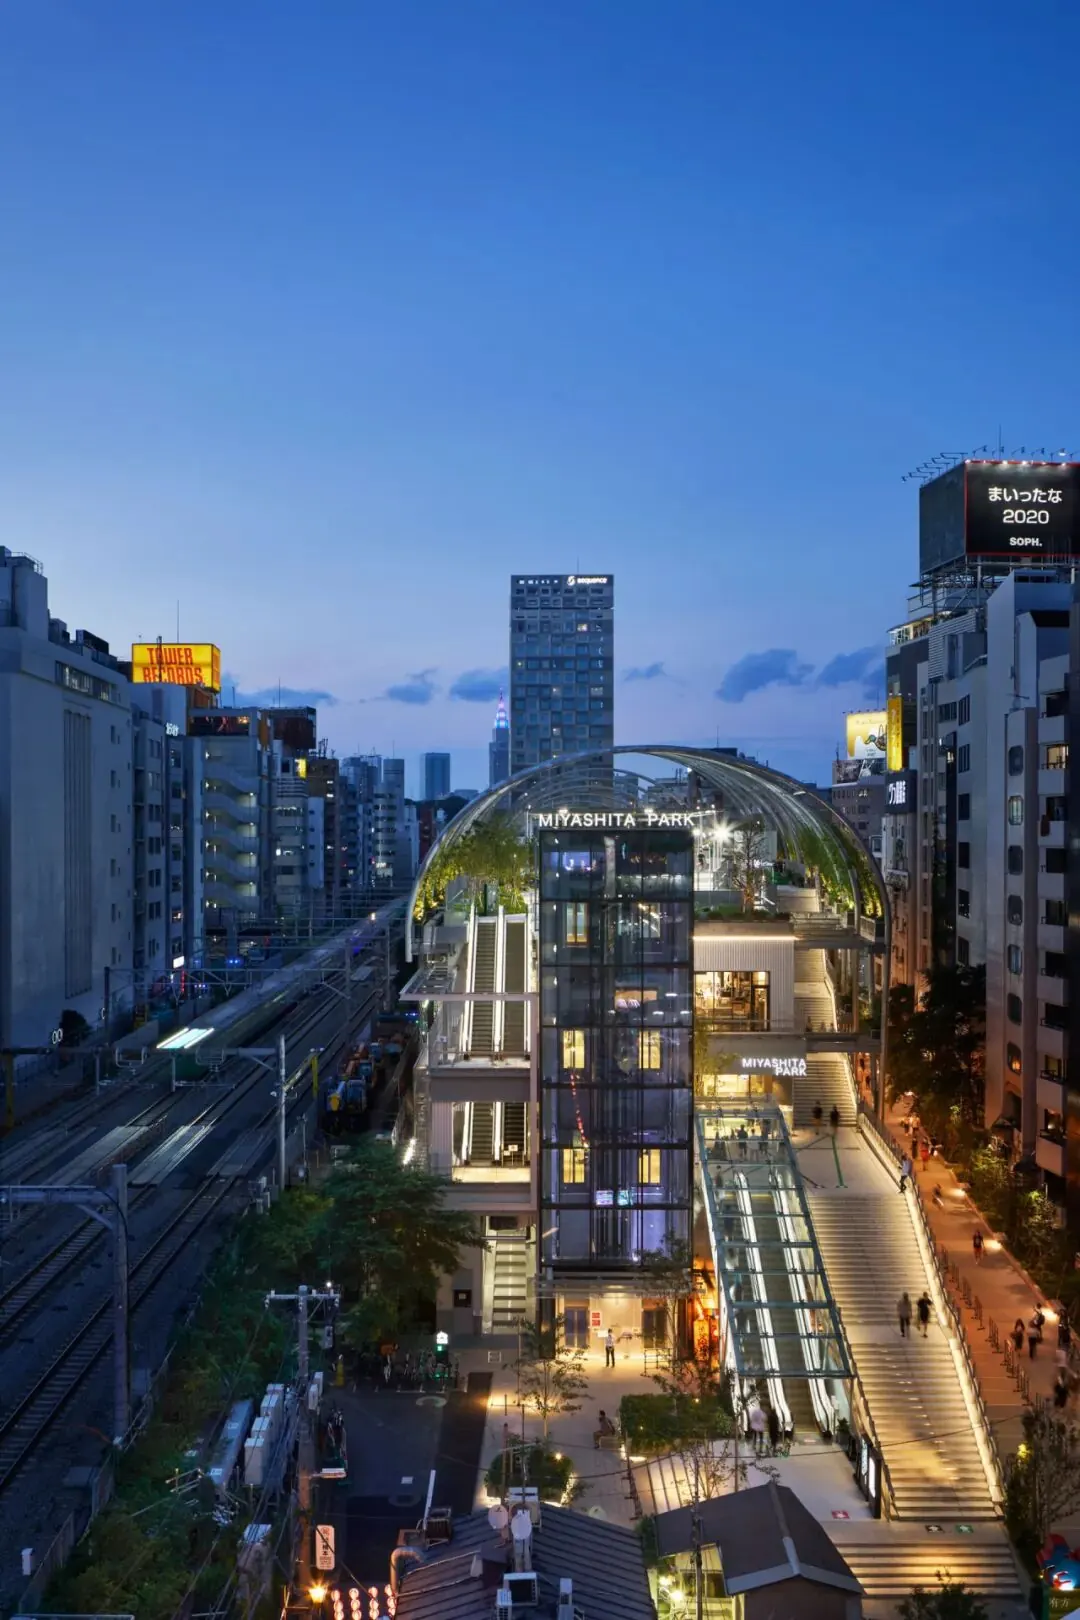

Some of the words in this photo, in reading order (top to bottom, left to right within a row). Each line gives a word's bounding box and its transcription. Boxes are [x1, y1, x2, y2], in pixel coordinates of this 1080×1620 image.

[988, 487, 1062, 503] まいったな
[1003, 509, 1049, 524] 2020
[1009, 537, 1043, 546] SOPH.
[538, 812, 636, 827] MIYASHITA
[647, 812, 695, 827] PARK
[742, 1058, 806, 1068] MIYASHITA
[775, 1066, 807, 1076] PARK
